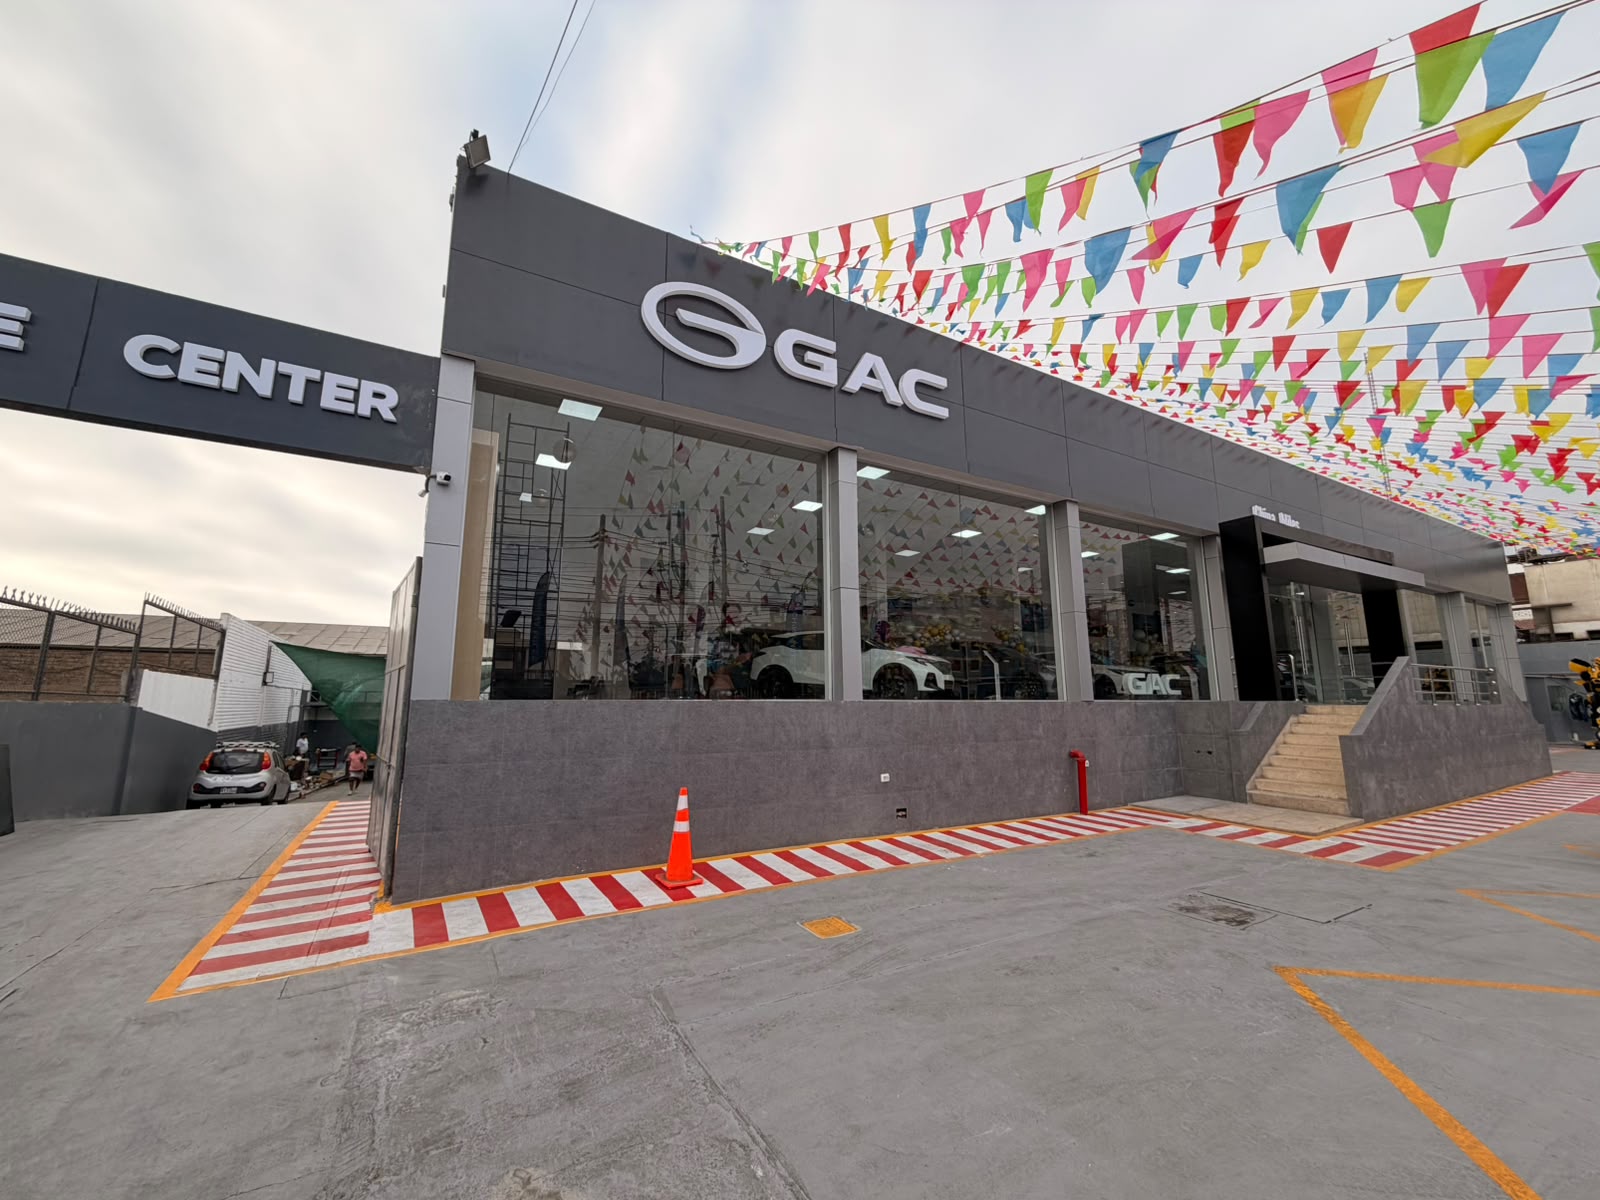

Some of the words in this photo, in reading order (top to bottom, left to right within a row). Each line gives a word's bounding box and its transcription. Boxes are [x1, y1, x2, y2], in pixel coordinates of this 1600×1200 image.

[123, 334, 399, 423] CENTER
[774, 328, 949, 420] GAC
[1122, 672, 1182, 696] GAC
